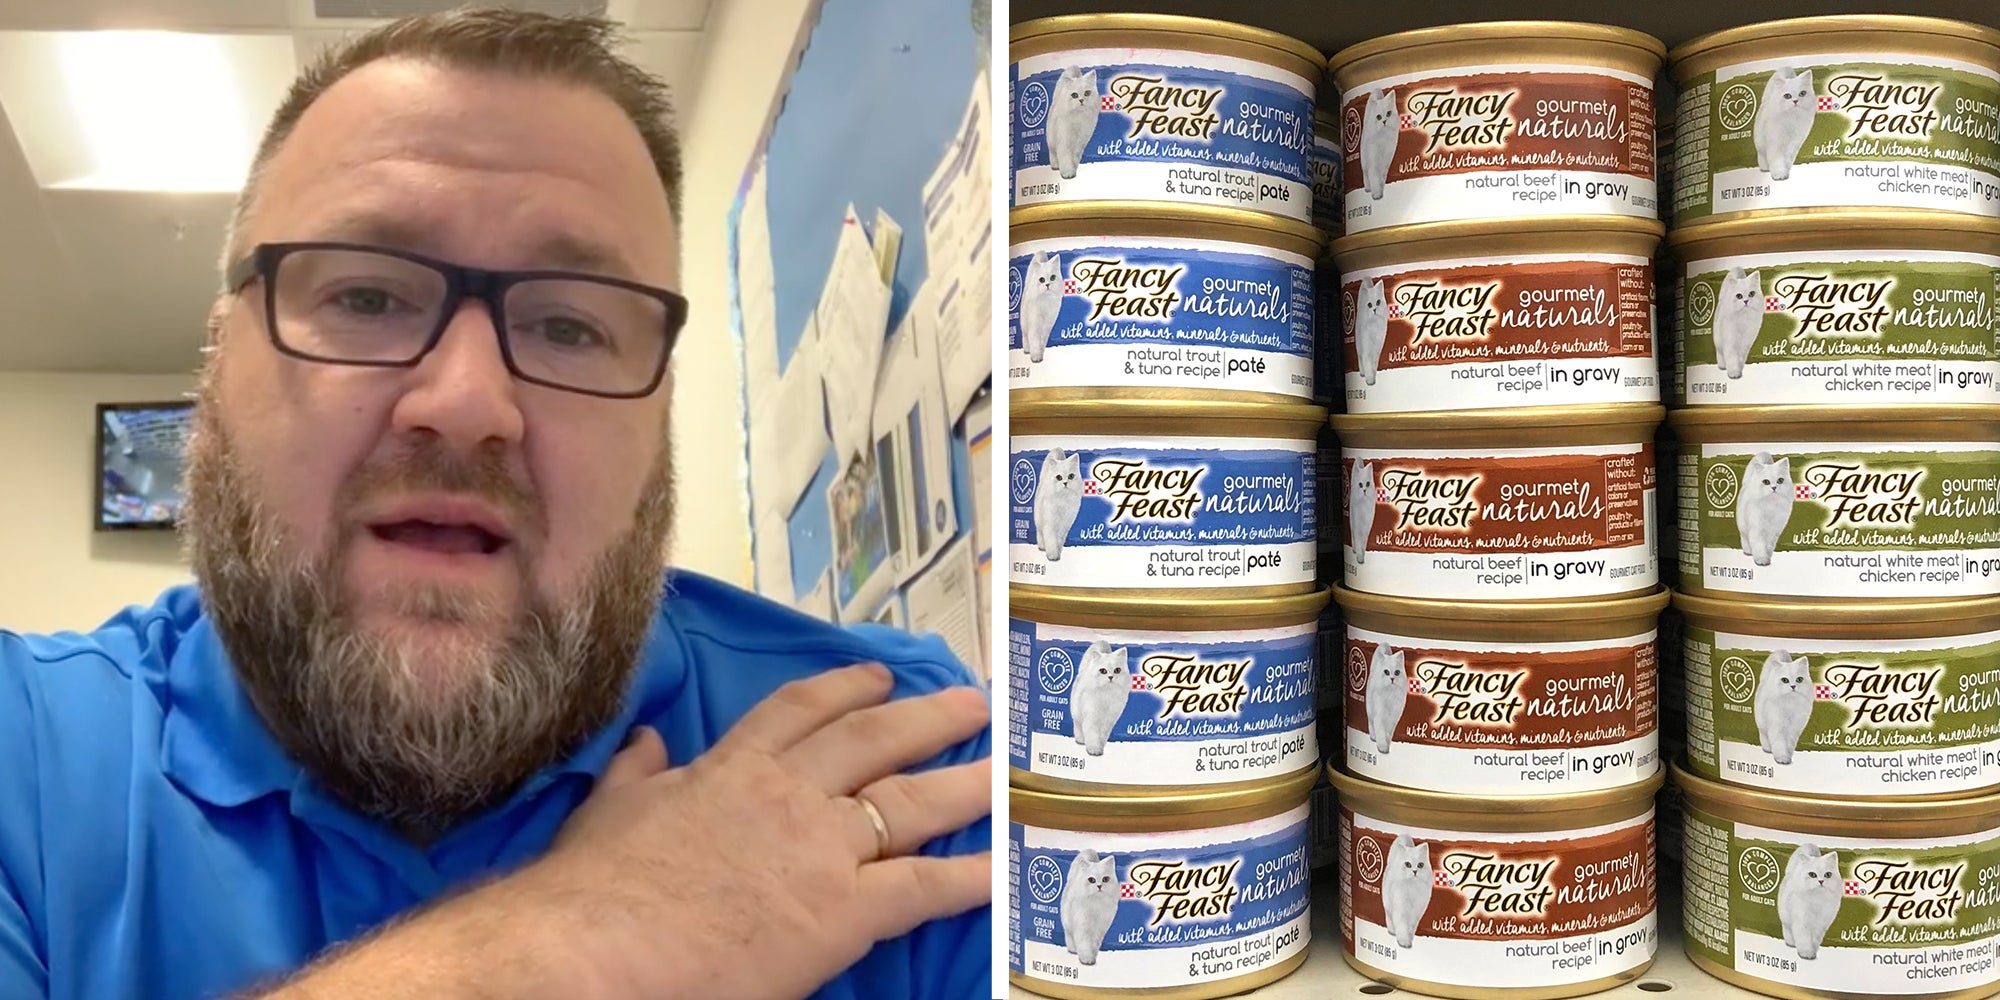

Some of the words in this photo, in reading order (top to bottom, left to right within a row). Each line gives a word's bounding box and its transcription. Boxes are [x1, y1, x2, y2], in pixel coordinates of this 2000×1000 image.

[1110, 75, 1223, 110] Fancy
[1407, 90, 1518, 122] Fancy
[1828, 75, 1940, 110] Fancy
[1125, 106, 1219, 138] Feast
[1240, 101, 1295, 126] gourmet
[1536, 99, 1608, 116] gourmet
[1842, 106, 1936, 137] Feast
[1222, 116, 1306, 154] naturals
[1421, 119, 1512, 152] Feast
[1518, 105, 1629, 143] naturals
[1940, 113, 2000, 141] natural
[1814, 139, 1840, 156] with
[1845, 140, 1878, 156] added
[1934, 145, 1973, 161] minerals
[1169, 167, 1220, 181] natural
[1225, 173, 1254, 186] trout
[1466, 175, 1519, 188] natural
[1524, 174, 1556, 186] beef
[1565, 179, 1581, 194] in
[1586, 181, 1628, 199] gravy
[1166, 181, 1176, 192] &
[1180, 181, 1212, 195] tuna
[1216, 187, 1254, 202] recipe
[1261, 184, 1289, 201] paté
[1512, 189, 1556, 203] recipe
[1072, 259, 1182, 295] Fancy
[1203, 277, 1271, 294] gourmet
[1088, 290, 1179, 321] Feast
[1184, 286, 1290, 323] naturals
[1395, 281, 1498, 316] Fancy
[1519, 285, 1595, 305] gourmet
[1774, 276, 1893, 310] Fancy
[1913, 287, 1979, 305] gourmet
[1501, 290, 1619, 328] naturals
[1792, 305, 1889, 338] Feast
[1894, 292, 1993, 329] naturals
[1061, 324, 1083, 339] with
[1085, 322, 1118, 338] added
[1176, 328, 1228, 341] minerals
[1409, 310, 1496, 342] Feast
[1791, 364, 1848, 377] natural
[1853, 364, 1891, 376] white
[1896, 365, 1931, 376] meat
[1939, 369, 1954, 384] in
[1958, 372, 1993, 389] gravy
[1825, 379, 1883, 391] chicken
[1888, 380, 1931, 394] recipe
[1093, 460, 1204, 494] Fancy
[1607, 457, 1634, 468] crafted
[1206, 475, 1301, 514] naturals
[1224, 472, 1287, 493] gourmet
[1382, 469, 1482, 502] Fancy
[1500, 478, 1579, 500] gourmet
[1805, 464, 1923, 499] Fancy
[1942, 476, 1997, 496] gourmet
[1111, 490, 1202, 522] Feast
[1397, 498, 1477, 529] Feast
[1482, 482, 1605, 522] naturals
[1824, 494, 1920, 528] Feast
[1925, 481, 2000, 519] natural
[1150, 549, 1204, 562] natural
[1208, 549, 1241, 561] trout
[1248, 552, 1281, 572] paté
[1433, 556, 1483, 570] natural
[1489, 556, 1521, 569] beef
[1531, 561, 1548, 576] in
[1554, 560, 1605, 579] gravy
[1147, 564, 1157, 576] &
[1161, 565, 1194, 577] tuna
[1199, 565, 1241, 579] recipe
[1477, 572, 1522, 587] recipe
[1142, 654, 1251, 689] Fancy
[1266, 660, 1312, 682] gourmet
[1416, 660, 1526, 696] Fancy
[1546, 672, 1617, 696] gourmet
[1825, 664, 1941, 699] Fancy
[1959, 669, 2000, 692] gourm
[1160, 685, 1247, 719] Feast
[1432, 690, 1522, 723] Feast
[1527, 674, 1635, 718] naturals
[1844, 694, 1939, 727] Feast
[1042, 708, 1063, 720] GRAIN
[1044, 719, 1060, 730] FREE
[1407, 723, 1428, 738] with
[1431, 726, 1462, 743] added
[1520, 727, 1571, 744] minerals
[1039, 752, 1048, 763] NET
[1049, 754, 1057, 764] WT
[1057, 755, 1061, 765] 3
[1061, 756, 1069, 766] OZ
[1070, 757, 1078, 768] (85
[1079, 759, 1085, 769] g)
[1846, 755, 1902, 768] natural
[1907, 755, 1943, 766] white
[1947, 751, 1977, 764] meat
[1881, 769, 1936, 783] chicken
[1940, 765, 1977, 779] recipe
[1131, 859, 1240, 894] Fancy
[1256, 849, 1302, 879] gourmet
[1443, 853, 1555, 891] Fancy
[1558, 851, 1646, 904] naturals
[1575, 850, 1633, 880] gourmet
[1855, 860, 1963, 895] Fancy
[1151, 888, 1238, 926] Feast
[1462, 883, 1553, 915] Feast
[1873, 891, 1961, 925] Feast
[1192, 944, 1240, 962] natural
[1244, 934, 1271, 952] trout
[1276, 927, 1299, 954] paté
[1506, 942, 1559, 957] natural
[1563, 938, 1592, 952] beef
[1599, 940, 1613, 955] in
[1616, 926, 1647, 954] gravy
[1189, 964, 1199, 976] &
[1202, 960, 1233, 975] tuna
[1237, 952, 1271, 970] recipe
[1552, 954, 1592, 970] recipe
[1744, 950, 1754, 961] NET
[1755, 954, 1766, 964] WT
[1766, 956, 1770, 966] 3
[1771, 957, 1779, 968] OZ
[1780, 959, 1789, 970] (85
[1791, 962, 1797, 972] g)
